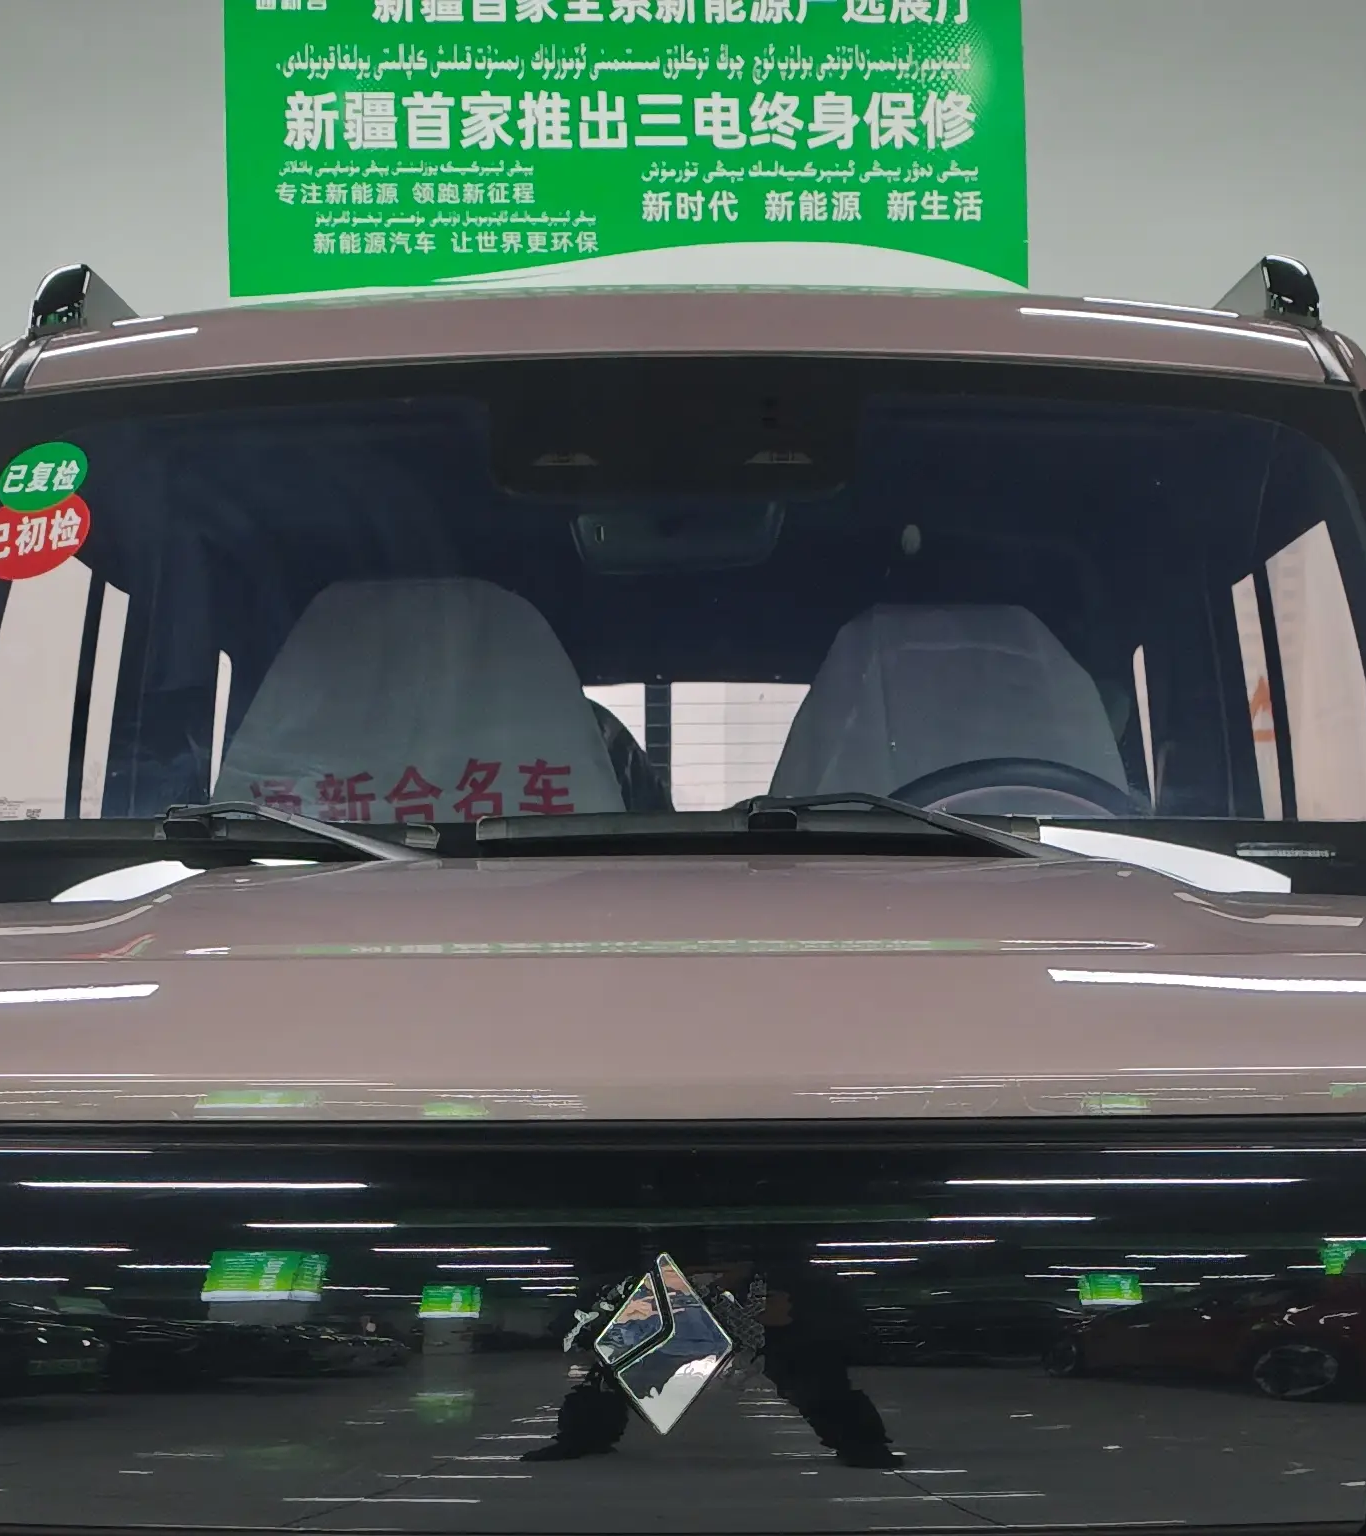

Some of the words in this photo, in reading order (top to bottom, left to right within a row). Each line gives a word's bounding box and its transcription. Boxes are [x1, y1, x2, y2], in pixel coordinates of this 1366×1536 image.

[283, 90, 977, 151] 新疆首家推出三电终身保修
[275, 182, 399, 205] 专注新能源
[411, 182, 536, 205] 领跑新征程
[641, 190, 739, 222] 新时代
[764, 190, 862, 222] 新能源
[886, 190, 984, 222] 新生活
[313, 231, 436, 254] 新能源汽车
[451, 231, 600, 254] 让世界更环保
[2, 460, 81, 493] 已复检
